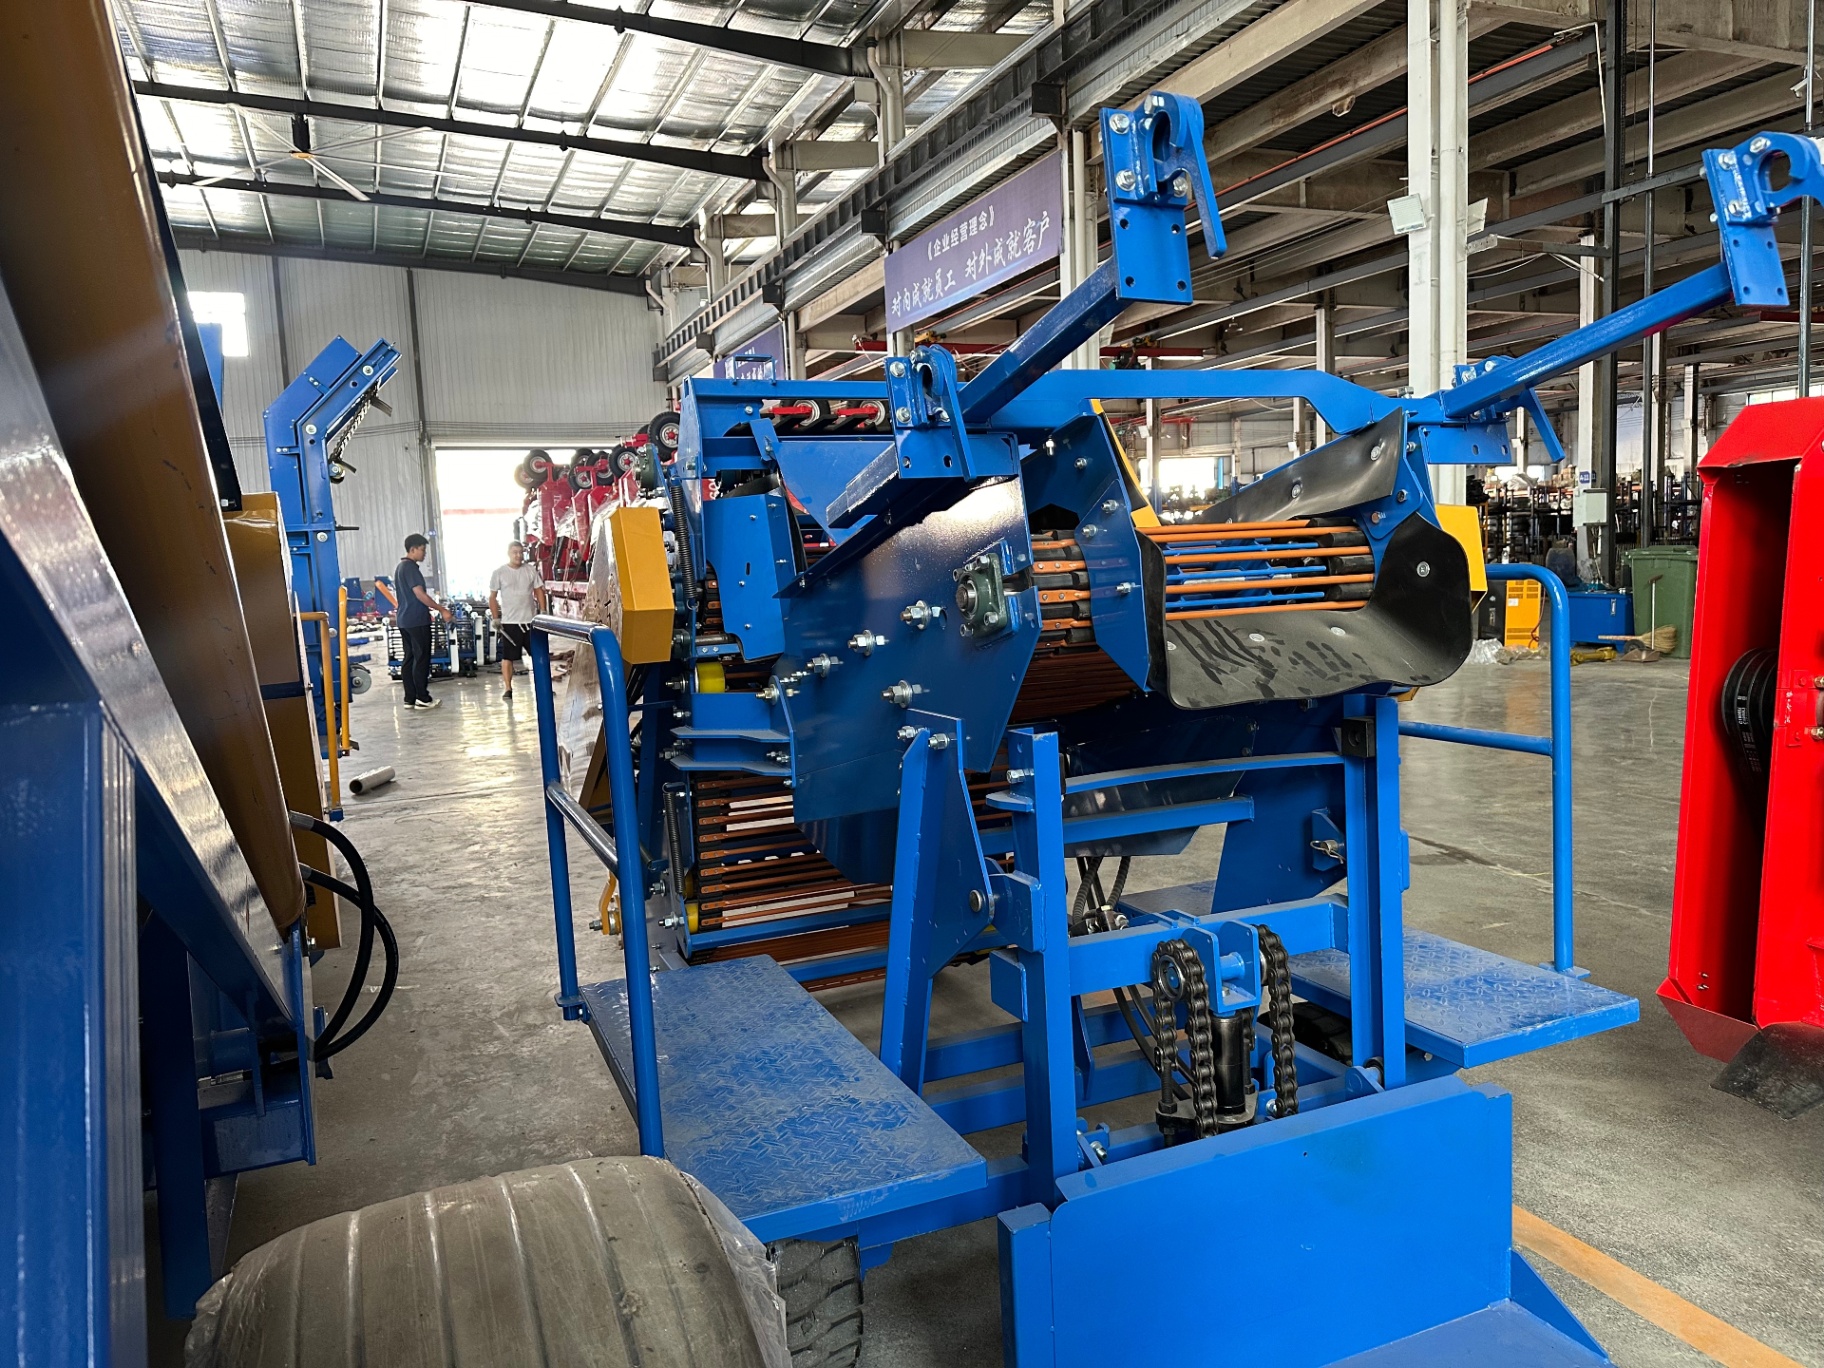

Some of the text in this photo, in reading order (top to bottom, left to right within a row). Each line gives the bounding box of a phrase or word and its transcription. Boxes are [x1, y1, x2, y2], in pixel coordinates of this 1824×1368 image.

[892, 210, 1050, 317] 对内成就员工 对外成就客户
